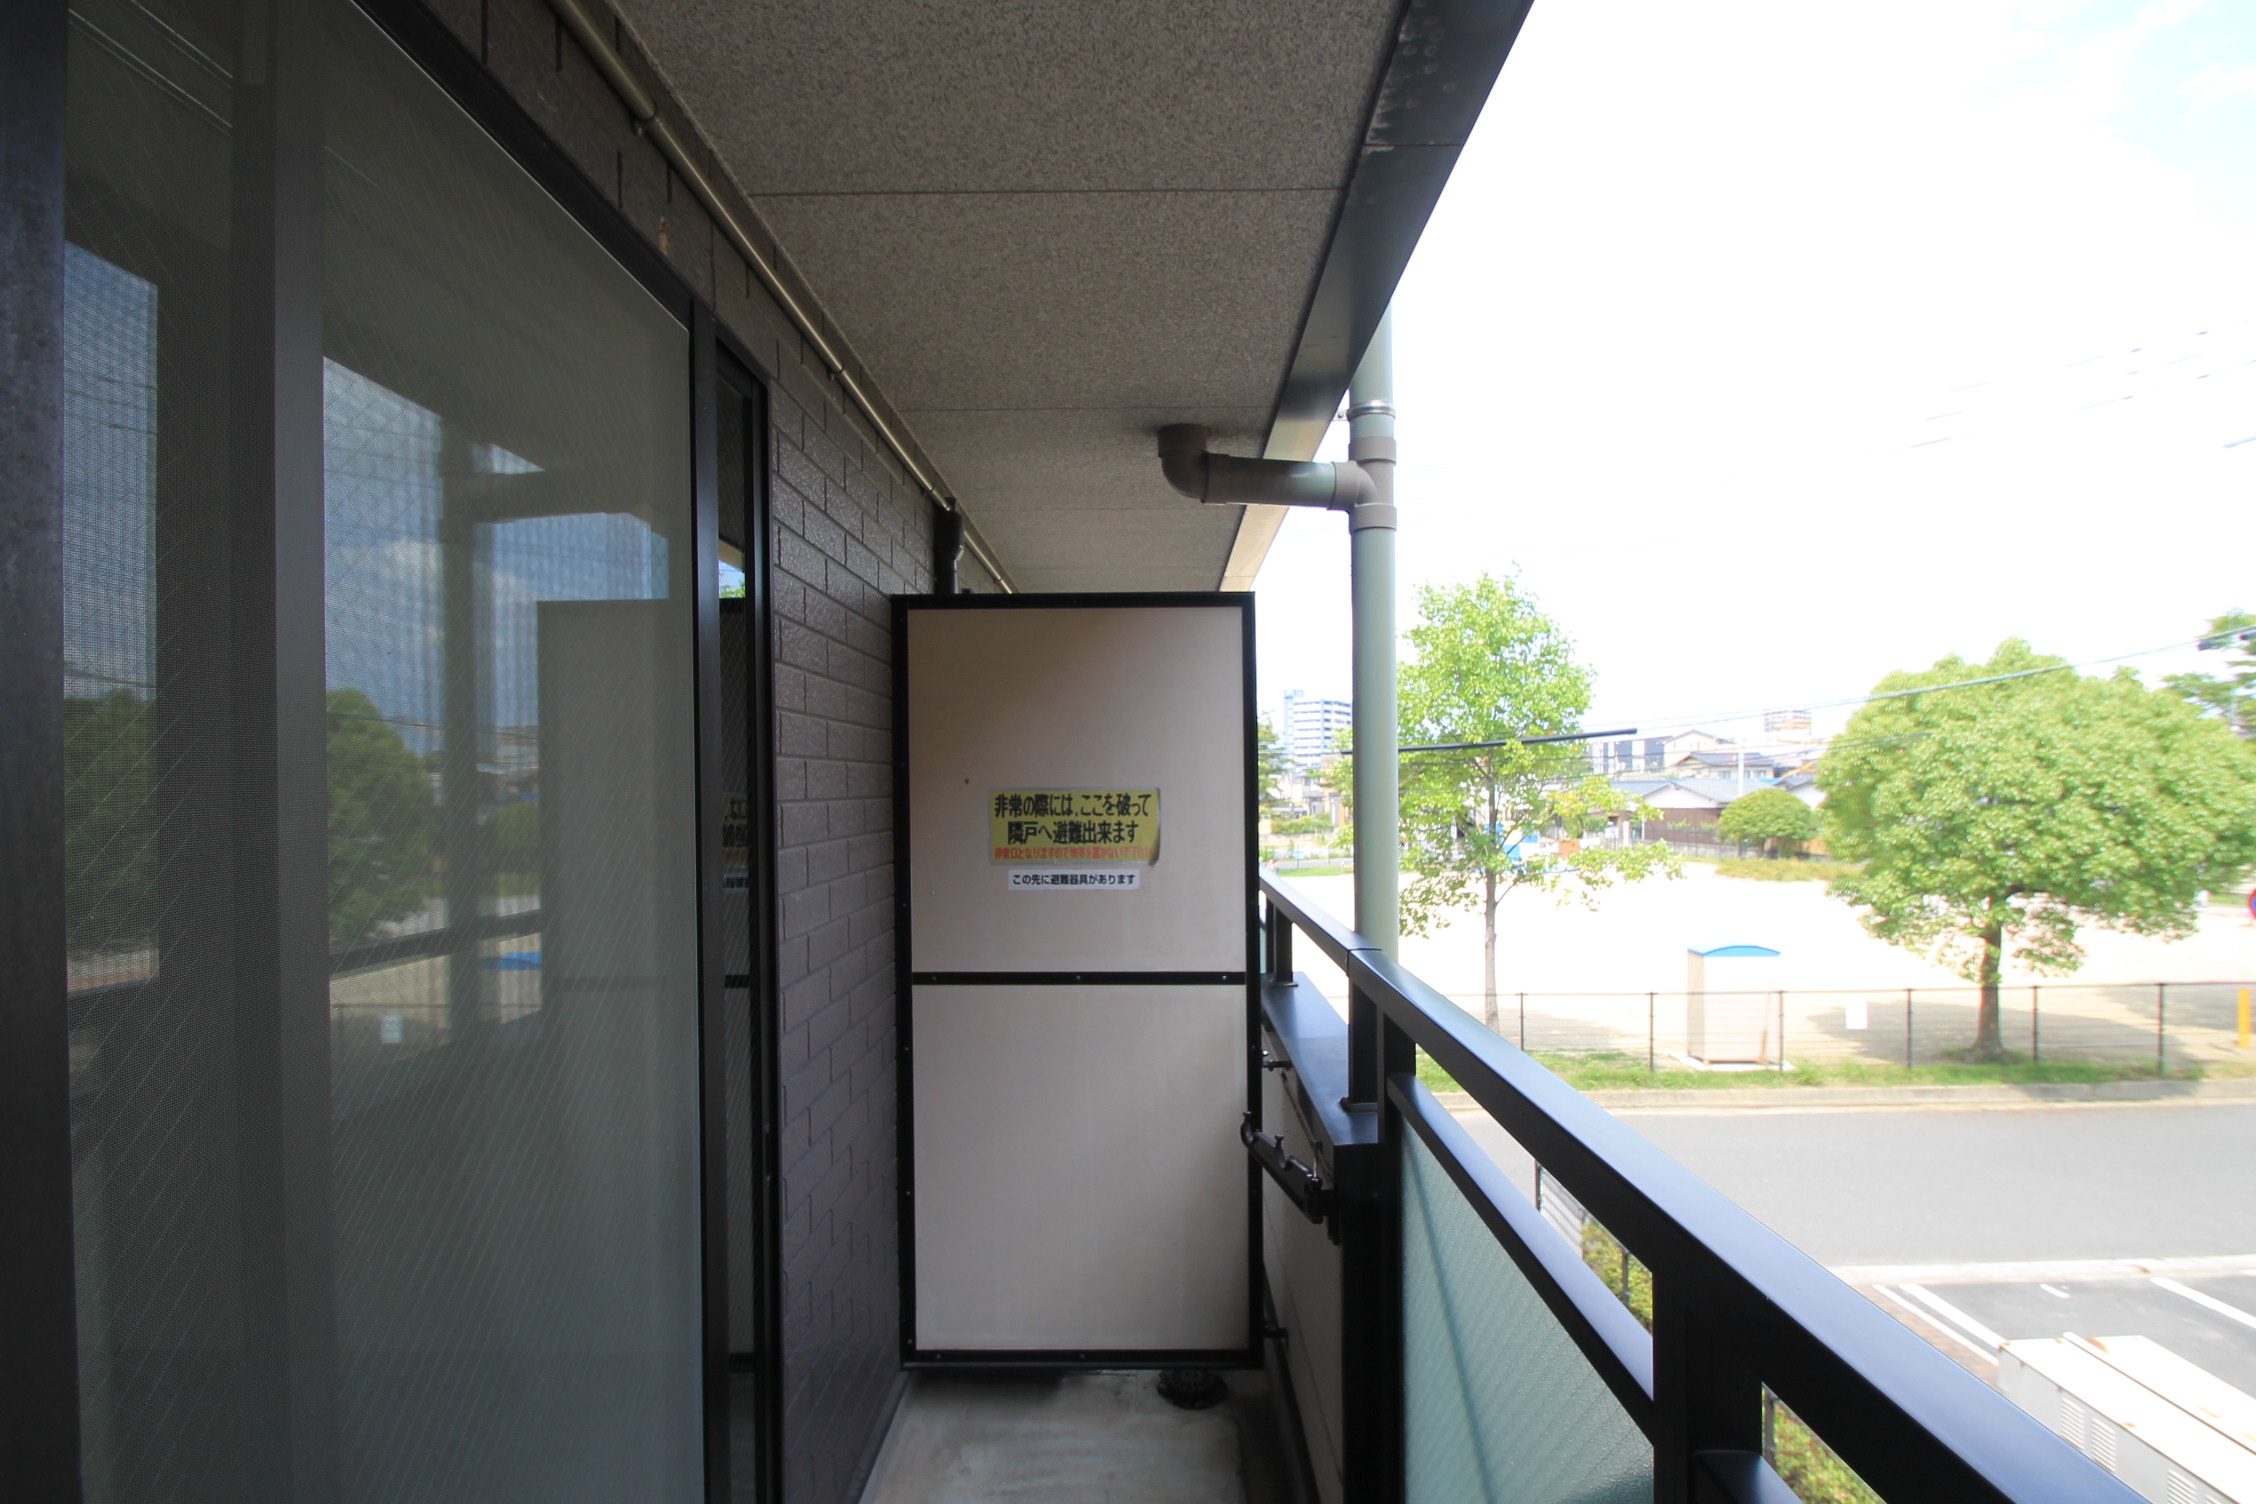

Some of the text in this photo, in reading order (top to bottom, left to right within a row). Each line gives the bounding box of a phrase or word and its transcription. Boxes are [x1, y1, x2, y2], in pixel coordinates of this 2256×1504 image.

[1009, 821, 1138, 845] 隣戸へ避難出来ます
[1012, 874, 1136, 886] この先に避難器具があります
